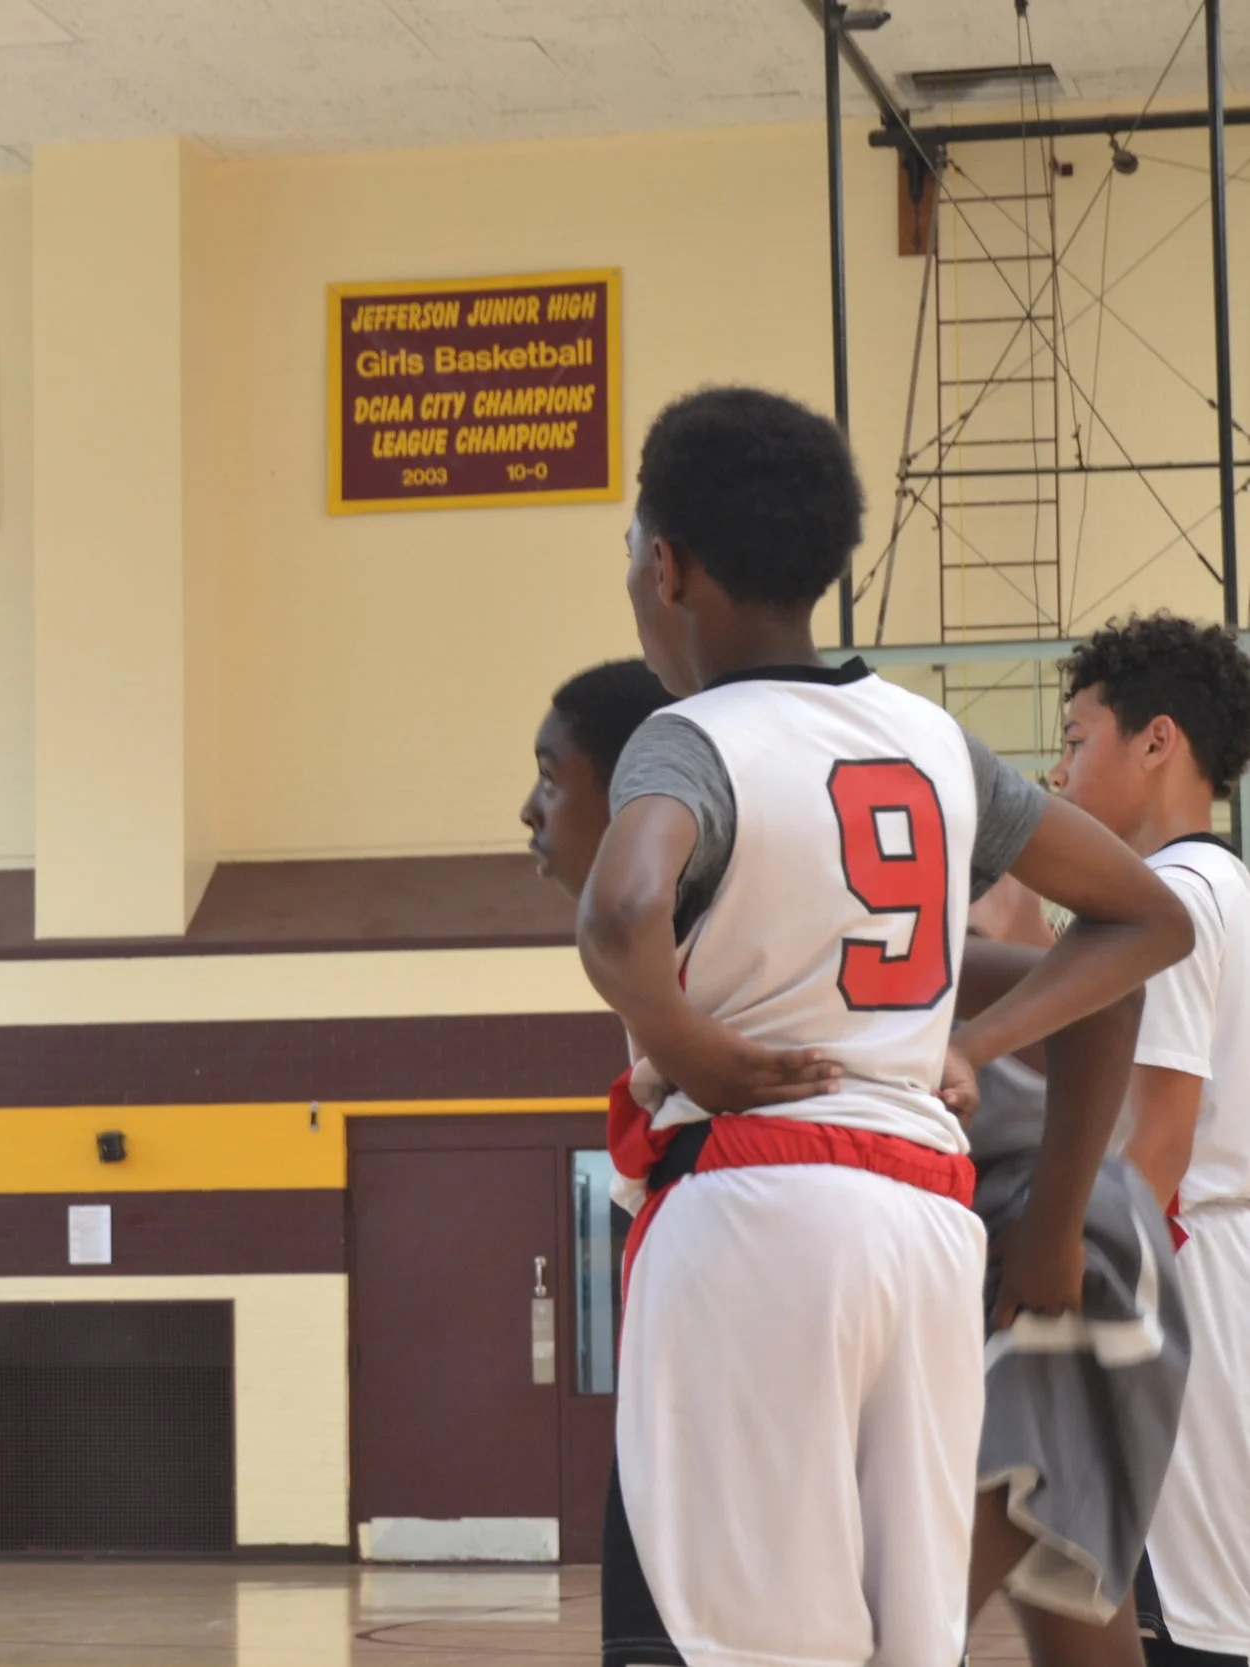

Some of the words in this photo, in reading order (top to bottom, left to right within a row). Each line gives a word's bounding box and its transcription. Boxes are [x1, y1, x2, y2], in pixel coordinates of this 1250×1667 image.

[351, 301, 460, 333] JEFFERSON
[467, 296, 540, 327] JUNIOR
[546, 291, 596, 322] HIGH
[356, 349, 424, 378] Girls
[435, 338, 592, 373] Basketball
[354, 395, 414, 424] DCIAA
[420, 391, 466, 421] CITY
[474, 384, 595, 418] CHAMPIONS
[372, 428, 448, 459] LEAGUE
[455, 421, 577, 454] CHAMPIONS
[402, 467, 448, 486] 2003
[506, 462, 548, 481] 10-0
[826, 757, 953, 1011] 9
